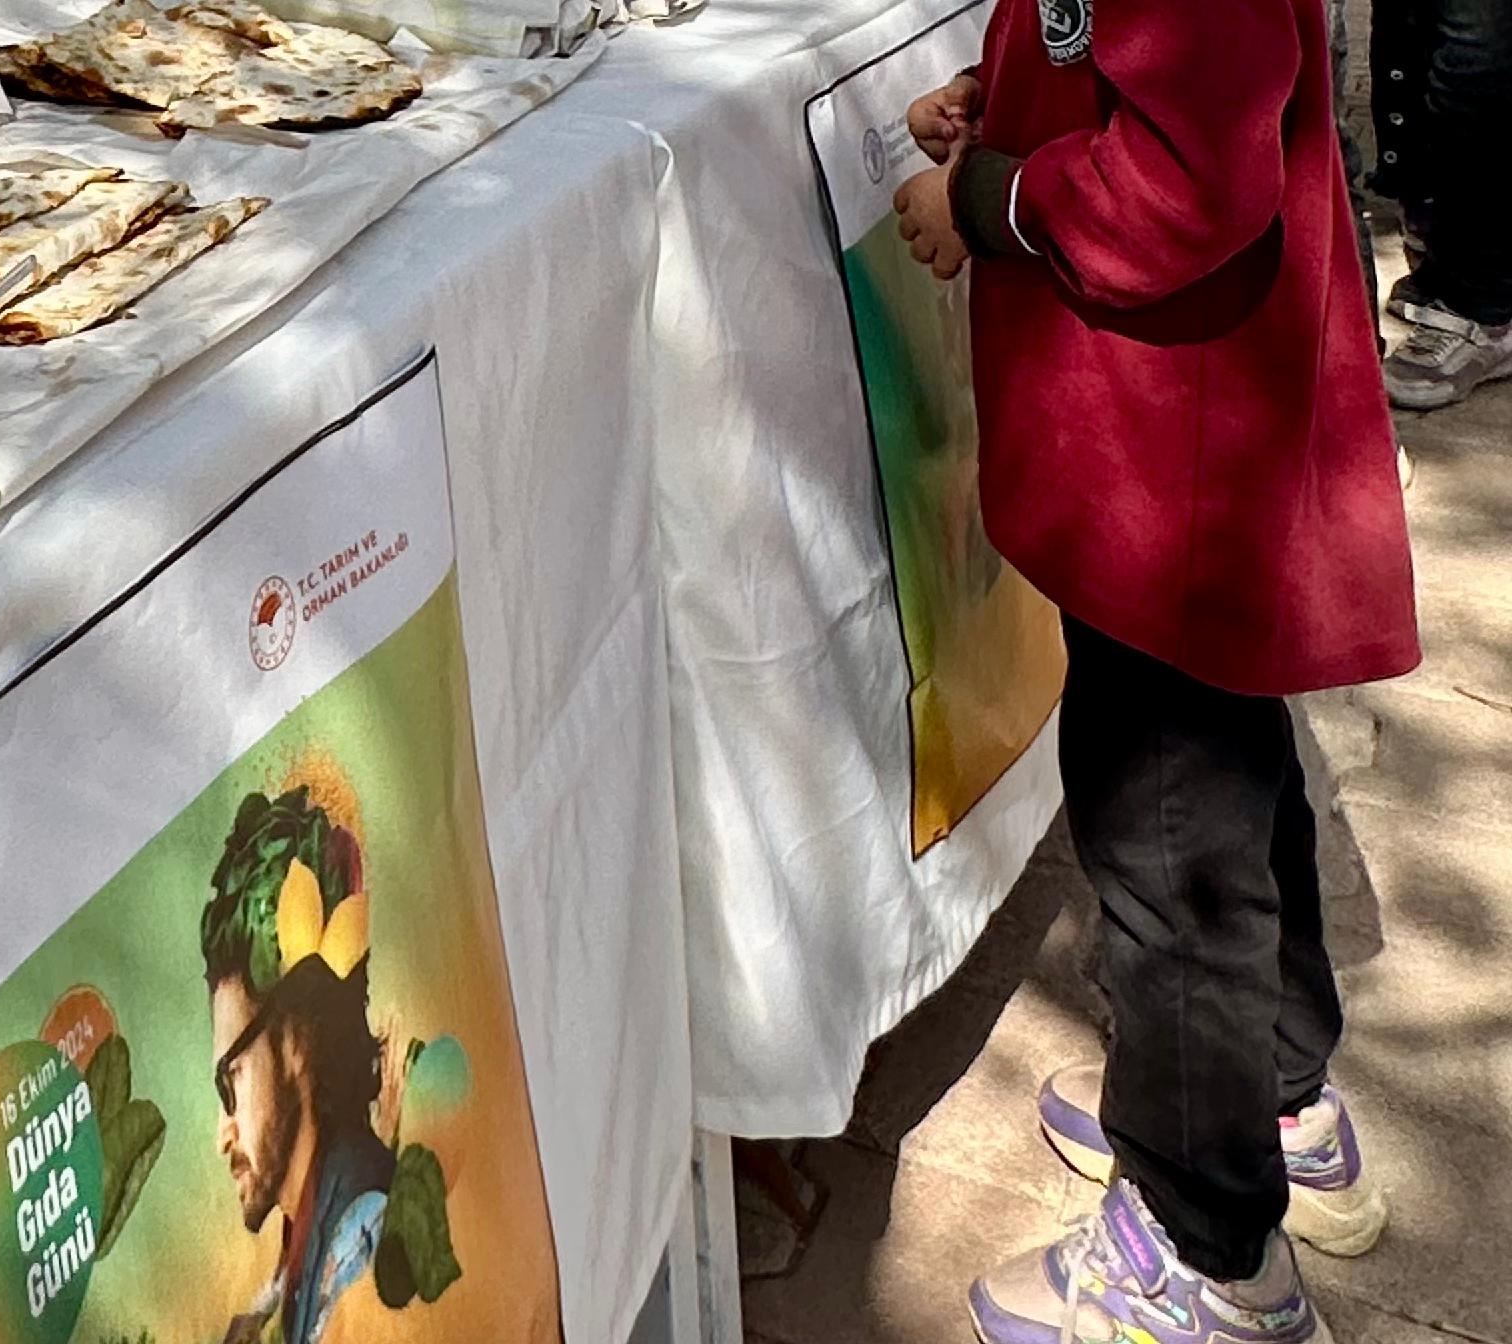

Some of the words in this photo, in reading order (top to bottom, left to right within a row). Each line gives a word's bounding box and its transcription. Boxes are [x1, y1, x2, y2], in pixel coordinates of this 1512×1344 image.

[302, 578, 348, 622] ORMAN
[319, 542, 360, 580] TARIM
[361, 529, 378, 552] VE
[0, 1098, 19, 1131] 16
[18, 1057, 59, 1116] Ekim
[57, 1021, 96, 1070] 2024
[6, 1080, 93, 1193] Dünya
[16, 1166, 79, 1254] Gıda
[26, 1206, 97, 1319] Günü
